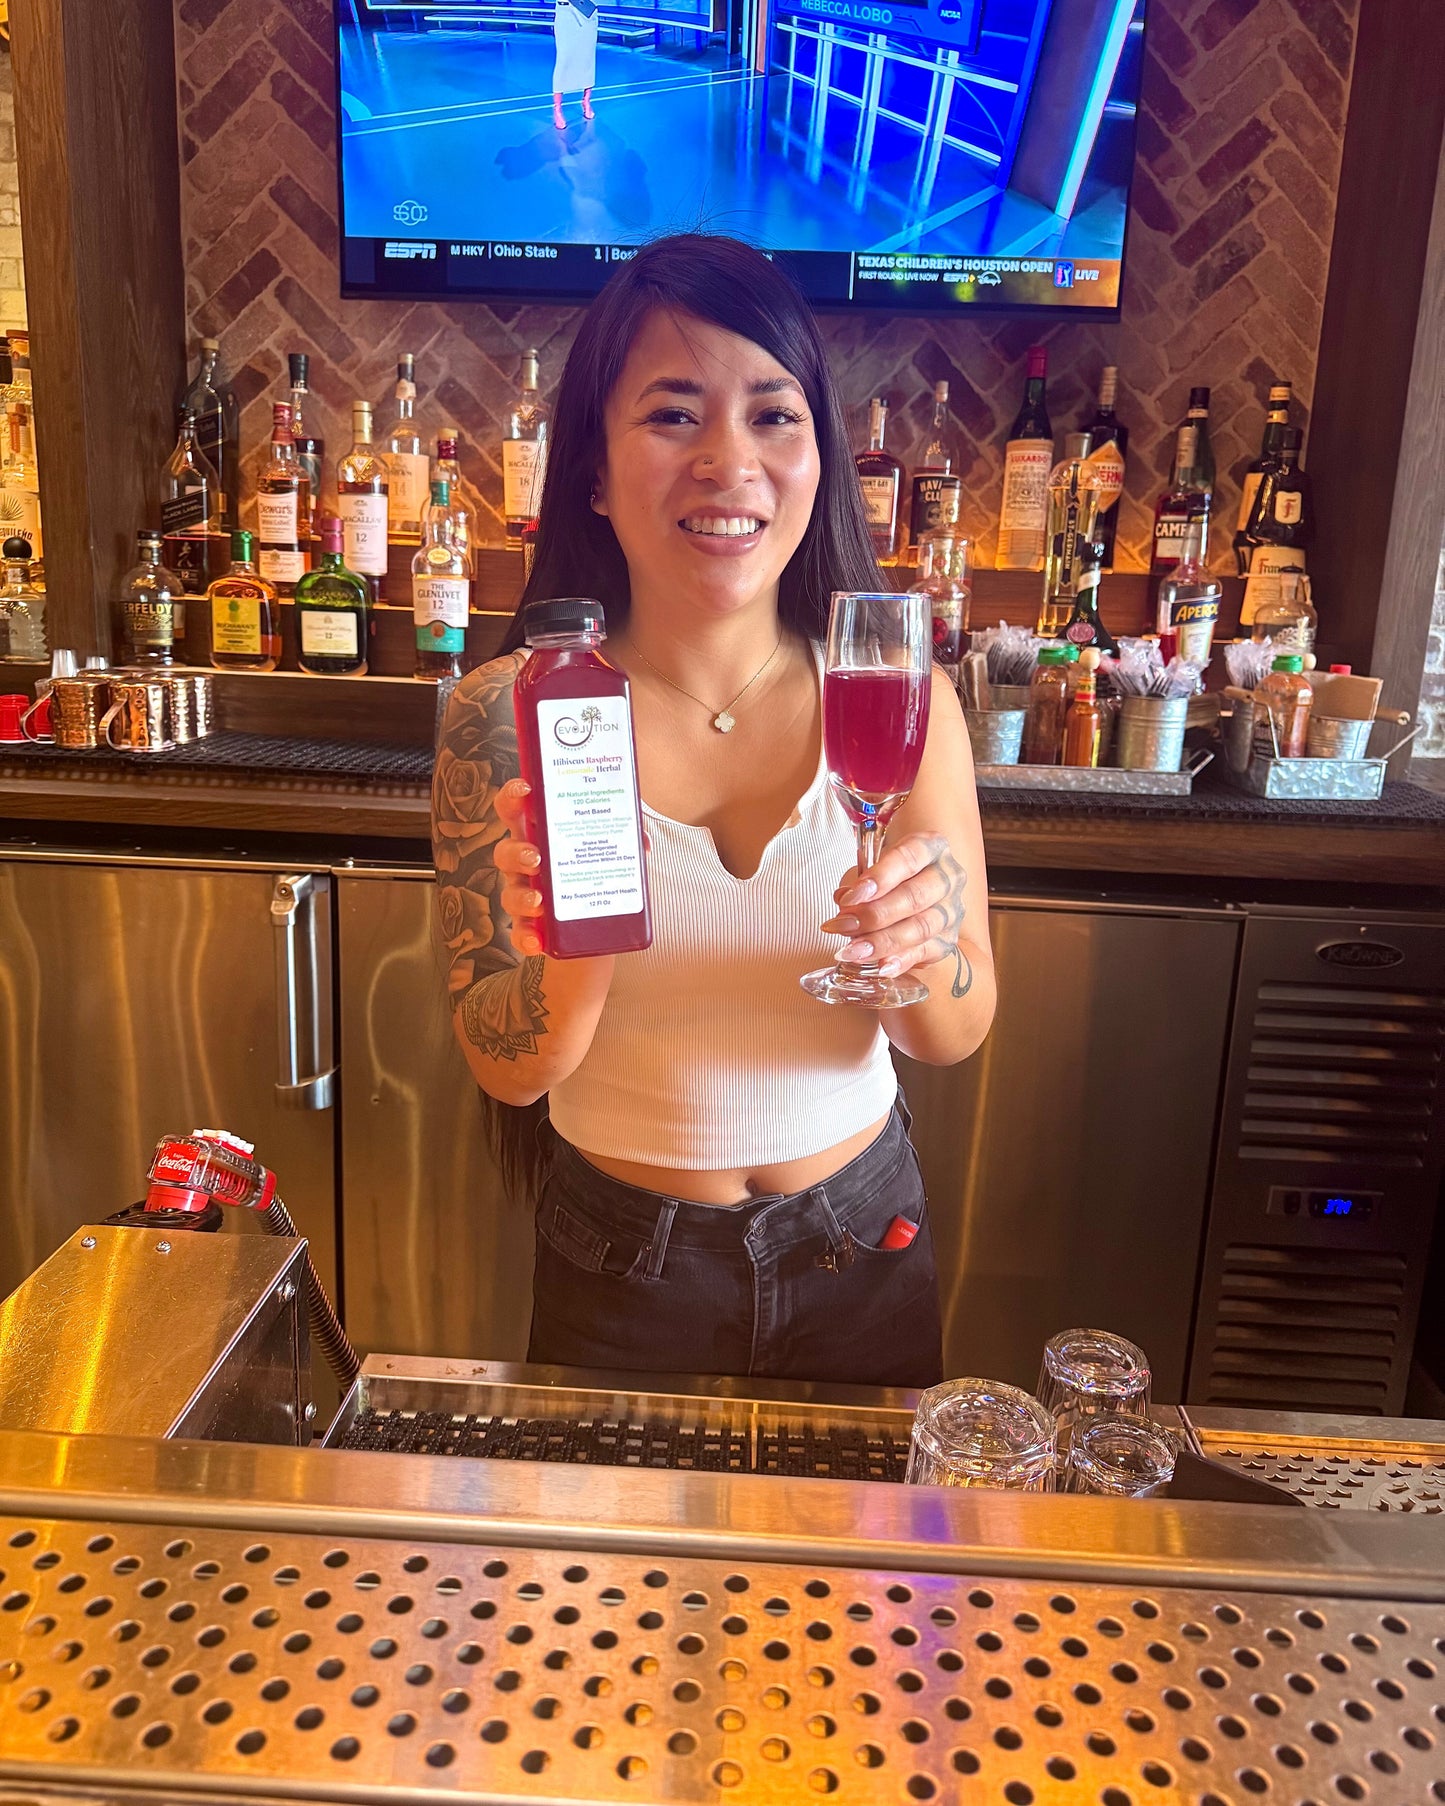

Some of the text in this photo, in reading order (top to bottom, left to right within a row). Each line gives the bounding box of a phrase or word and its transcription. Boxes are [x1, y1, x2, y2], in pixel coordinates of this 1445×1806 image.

[802, 0, 893, 24] REBECCA LOBO
[384, 242, 437, 259] ESPN
[450, 244, 558, 260] M HKY Ohio State
[594, 246, 602, 260] 1
[858, 255, 1053, 273] TEXAS CHILDREN'S HOUSTON OPEN
[858, 271, 877, 280] FIRST
[879, 271, 904, 281] ROUND
[904, 272, 919, 281] LIVE
[919, 273, 939, 282] NOW
[1074, 269, 1099, 281] LIVE
[520, 477, 530, 486] 18
[356, 532, 368, 543] 12
[417, 588, 461, 600] GLENLIVET
[432, 600, 444, 610] 12
[552, 755, 624, 767] Hibiscus Raspberry
[596, 763, 621, 773] Herbal
[566, 790, 590, 798] Natural
[590, 788, 625, 798] Ingredients
[584, 797, 611, 805] Calories
[591, 807, 612, 815] Based
[587, 844, 618, 852] Refrigerated
[576, 857, 600, 865] Consume
[573, 891, 596, 899] Support
[619, 887, 638, 895] Health
